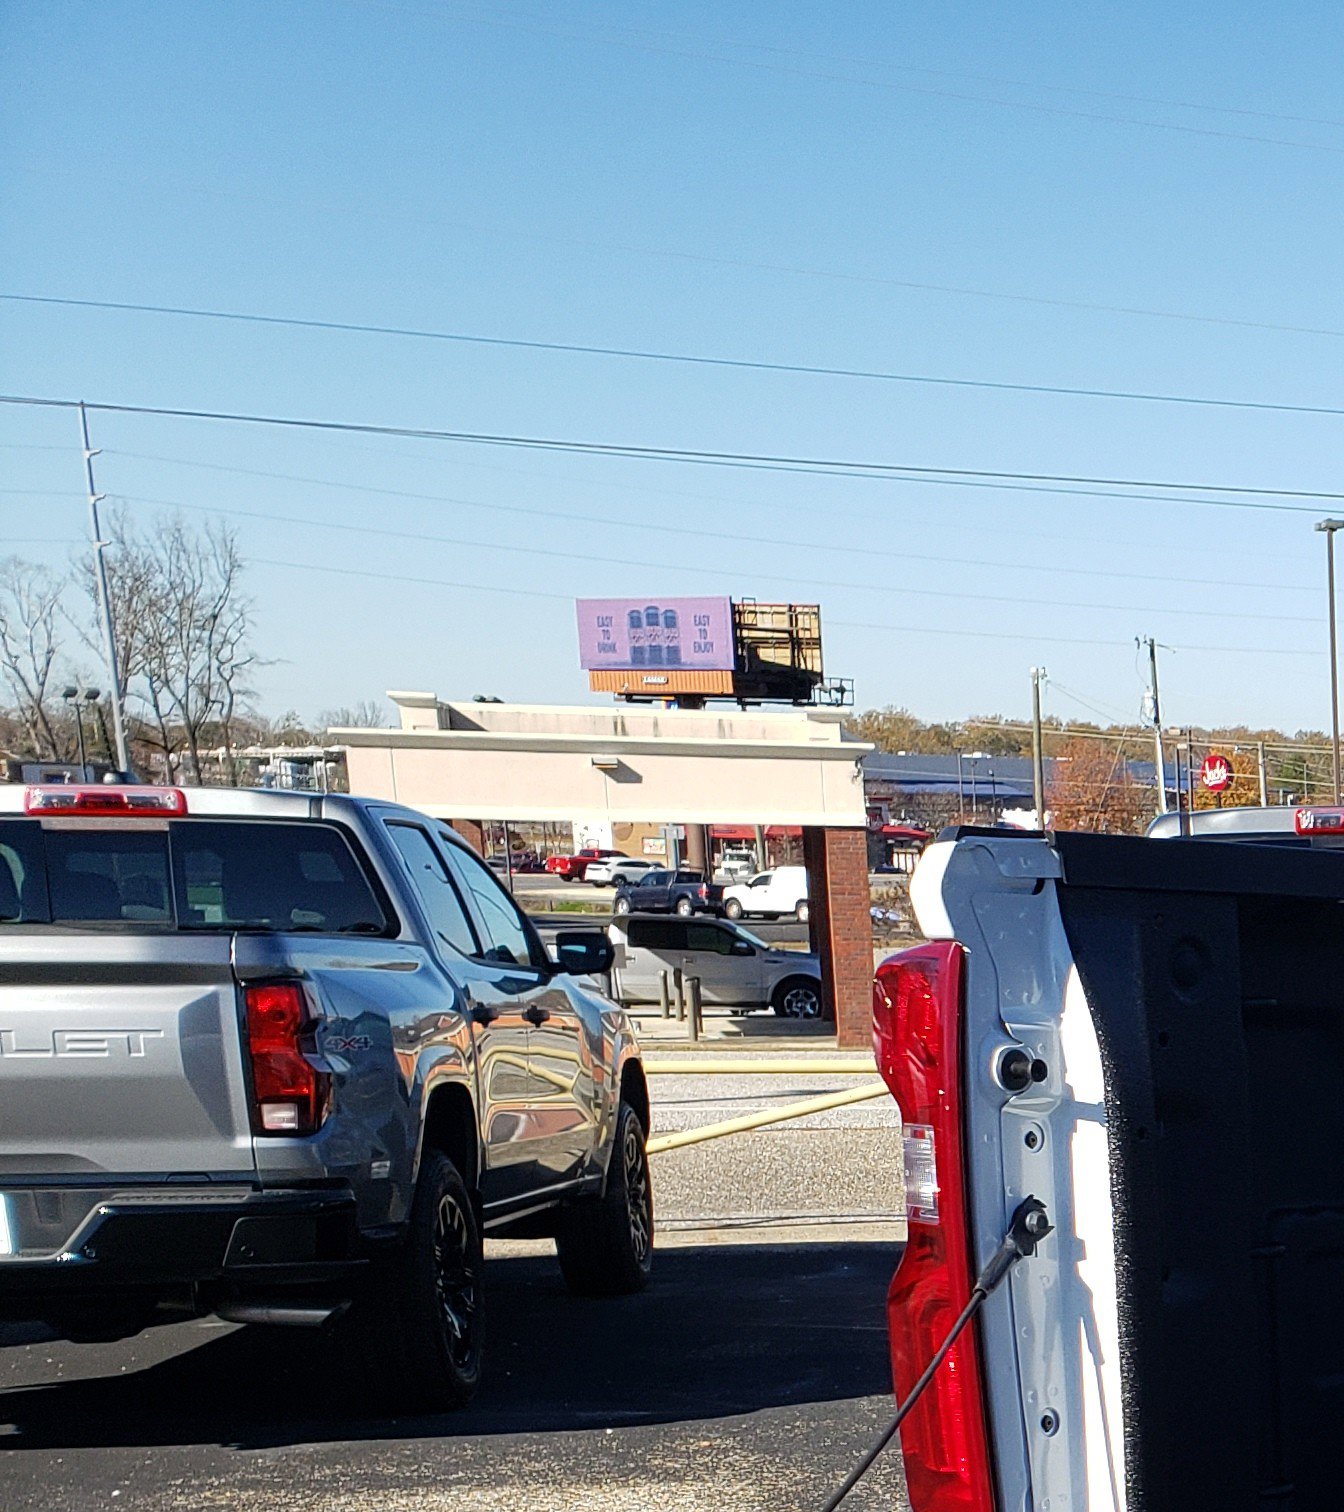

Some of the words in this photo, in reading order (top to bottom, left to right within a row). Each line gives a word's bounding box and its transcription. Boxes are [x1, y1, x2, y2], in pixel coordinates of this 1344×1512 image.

[694, 615, 710, 627] EASY
[602, 629, 611, 640] TO
[698, 628, 708, 640] TO
